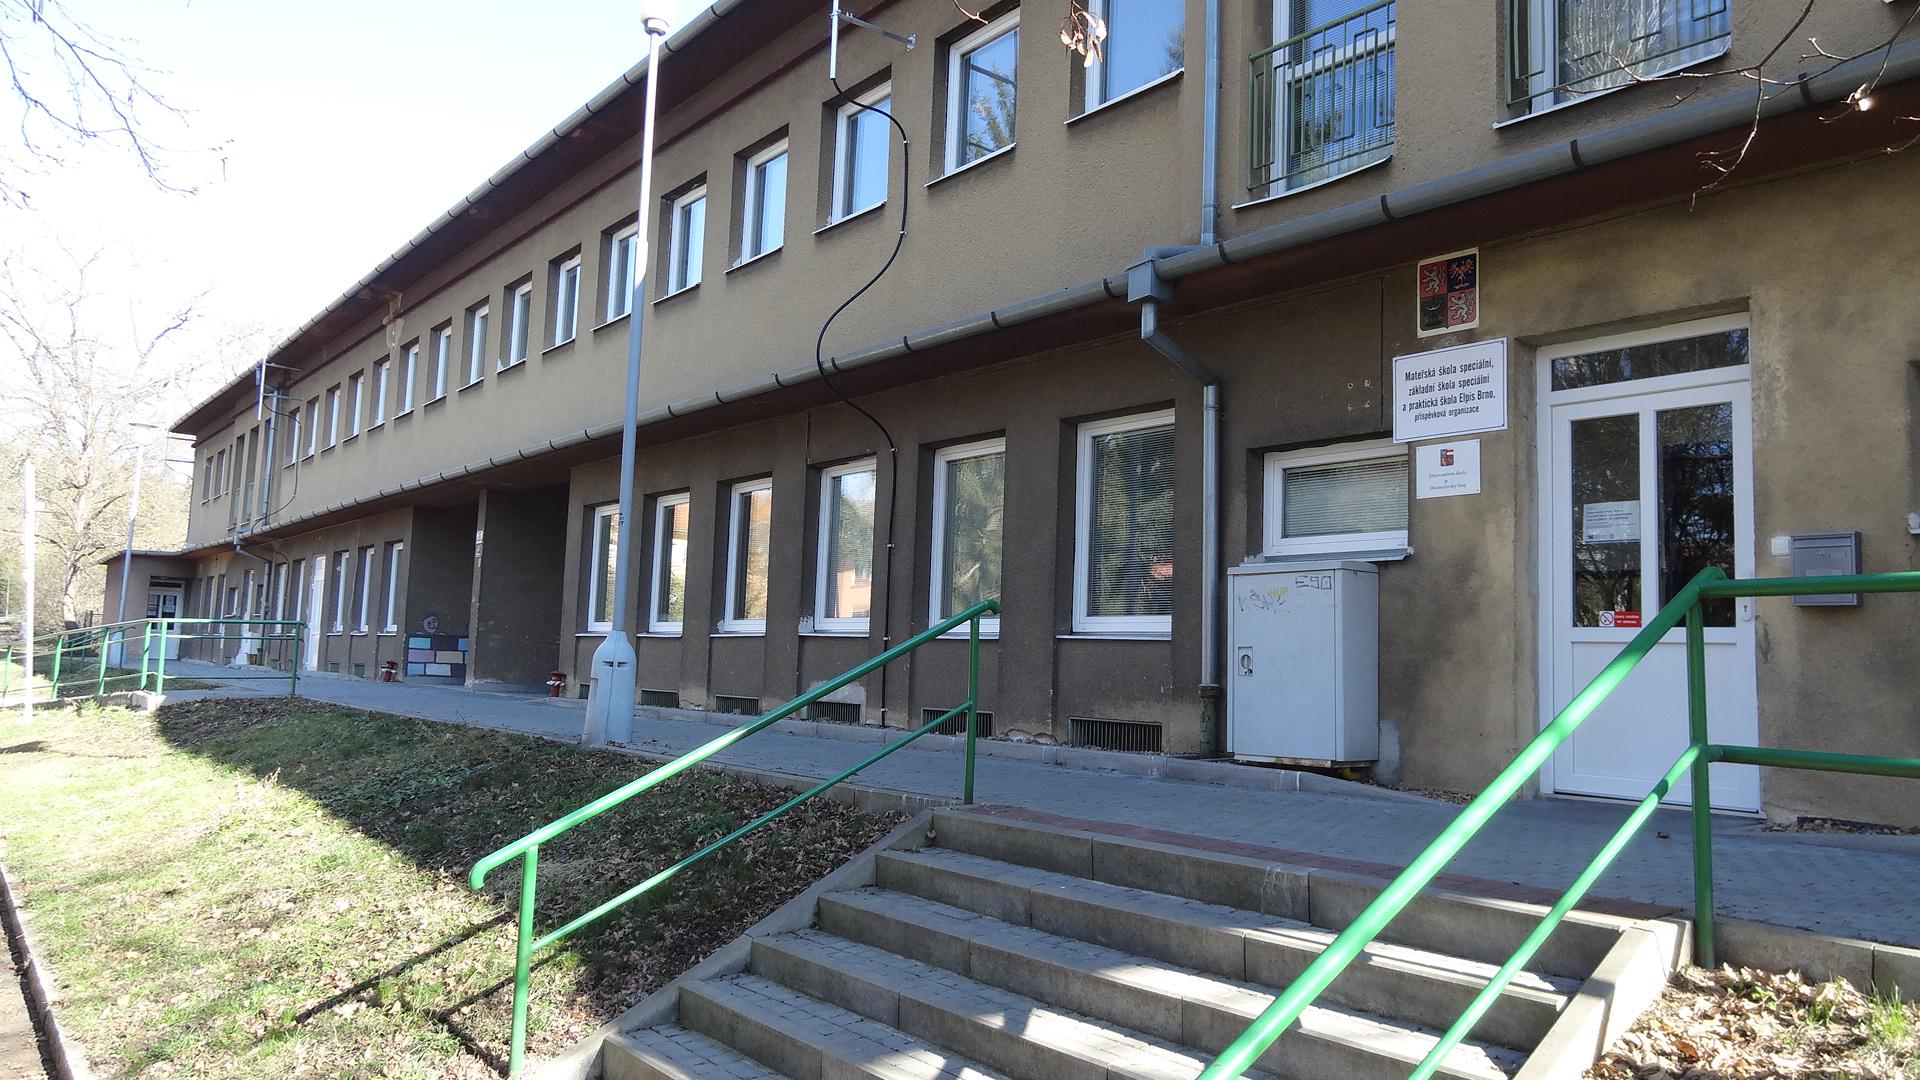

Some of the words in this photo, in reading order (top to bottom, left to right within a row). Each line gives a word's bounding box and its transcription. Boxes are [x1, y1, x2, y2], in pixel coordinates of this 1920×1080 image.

[1405, 368, 1436, 381] Mateřská
[1438, 364, 1457, 376] škola
[1460, 357, 1494, 373] speciální,
[1408, 383, 1435, 396] základní
[1437, 380, 1456, 391] škola
[1458, 373, 1490, 388] speciální
[1402, 403, 1407, 411] a
[1408, 397, 1439, 412] praktická
[1440, 394, 1457, 406] škola
[1459, 392, 1476, 404] Elpis
[1477, 389, 1496, 400] Brno,
[1414, 409, 1447, 422] příspěvková
[1448, 405, 1479, 417] organizace
